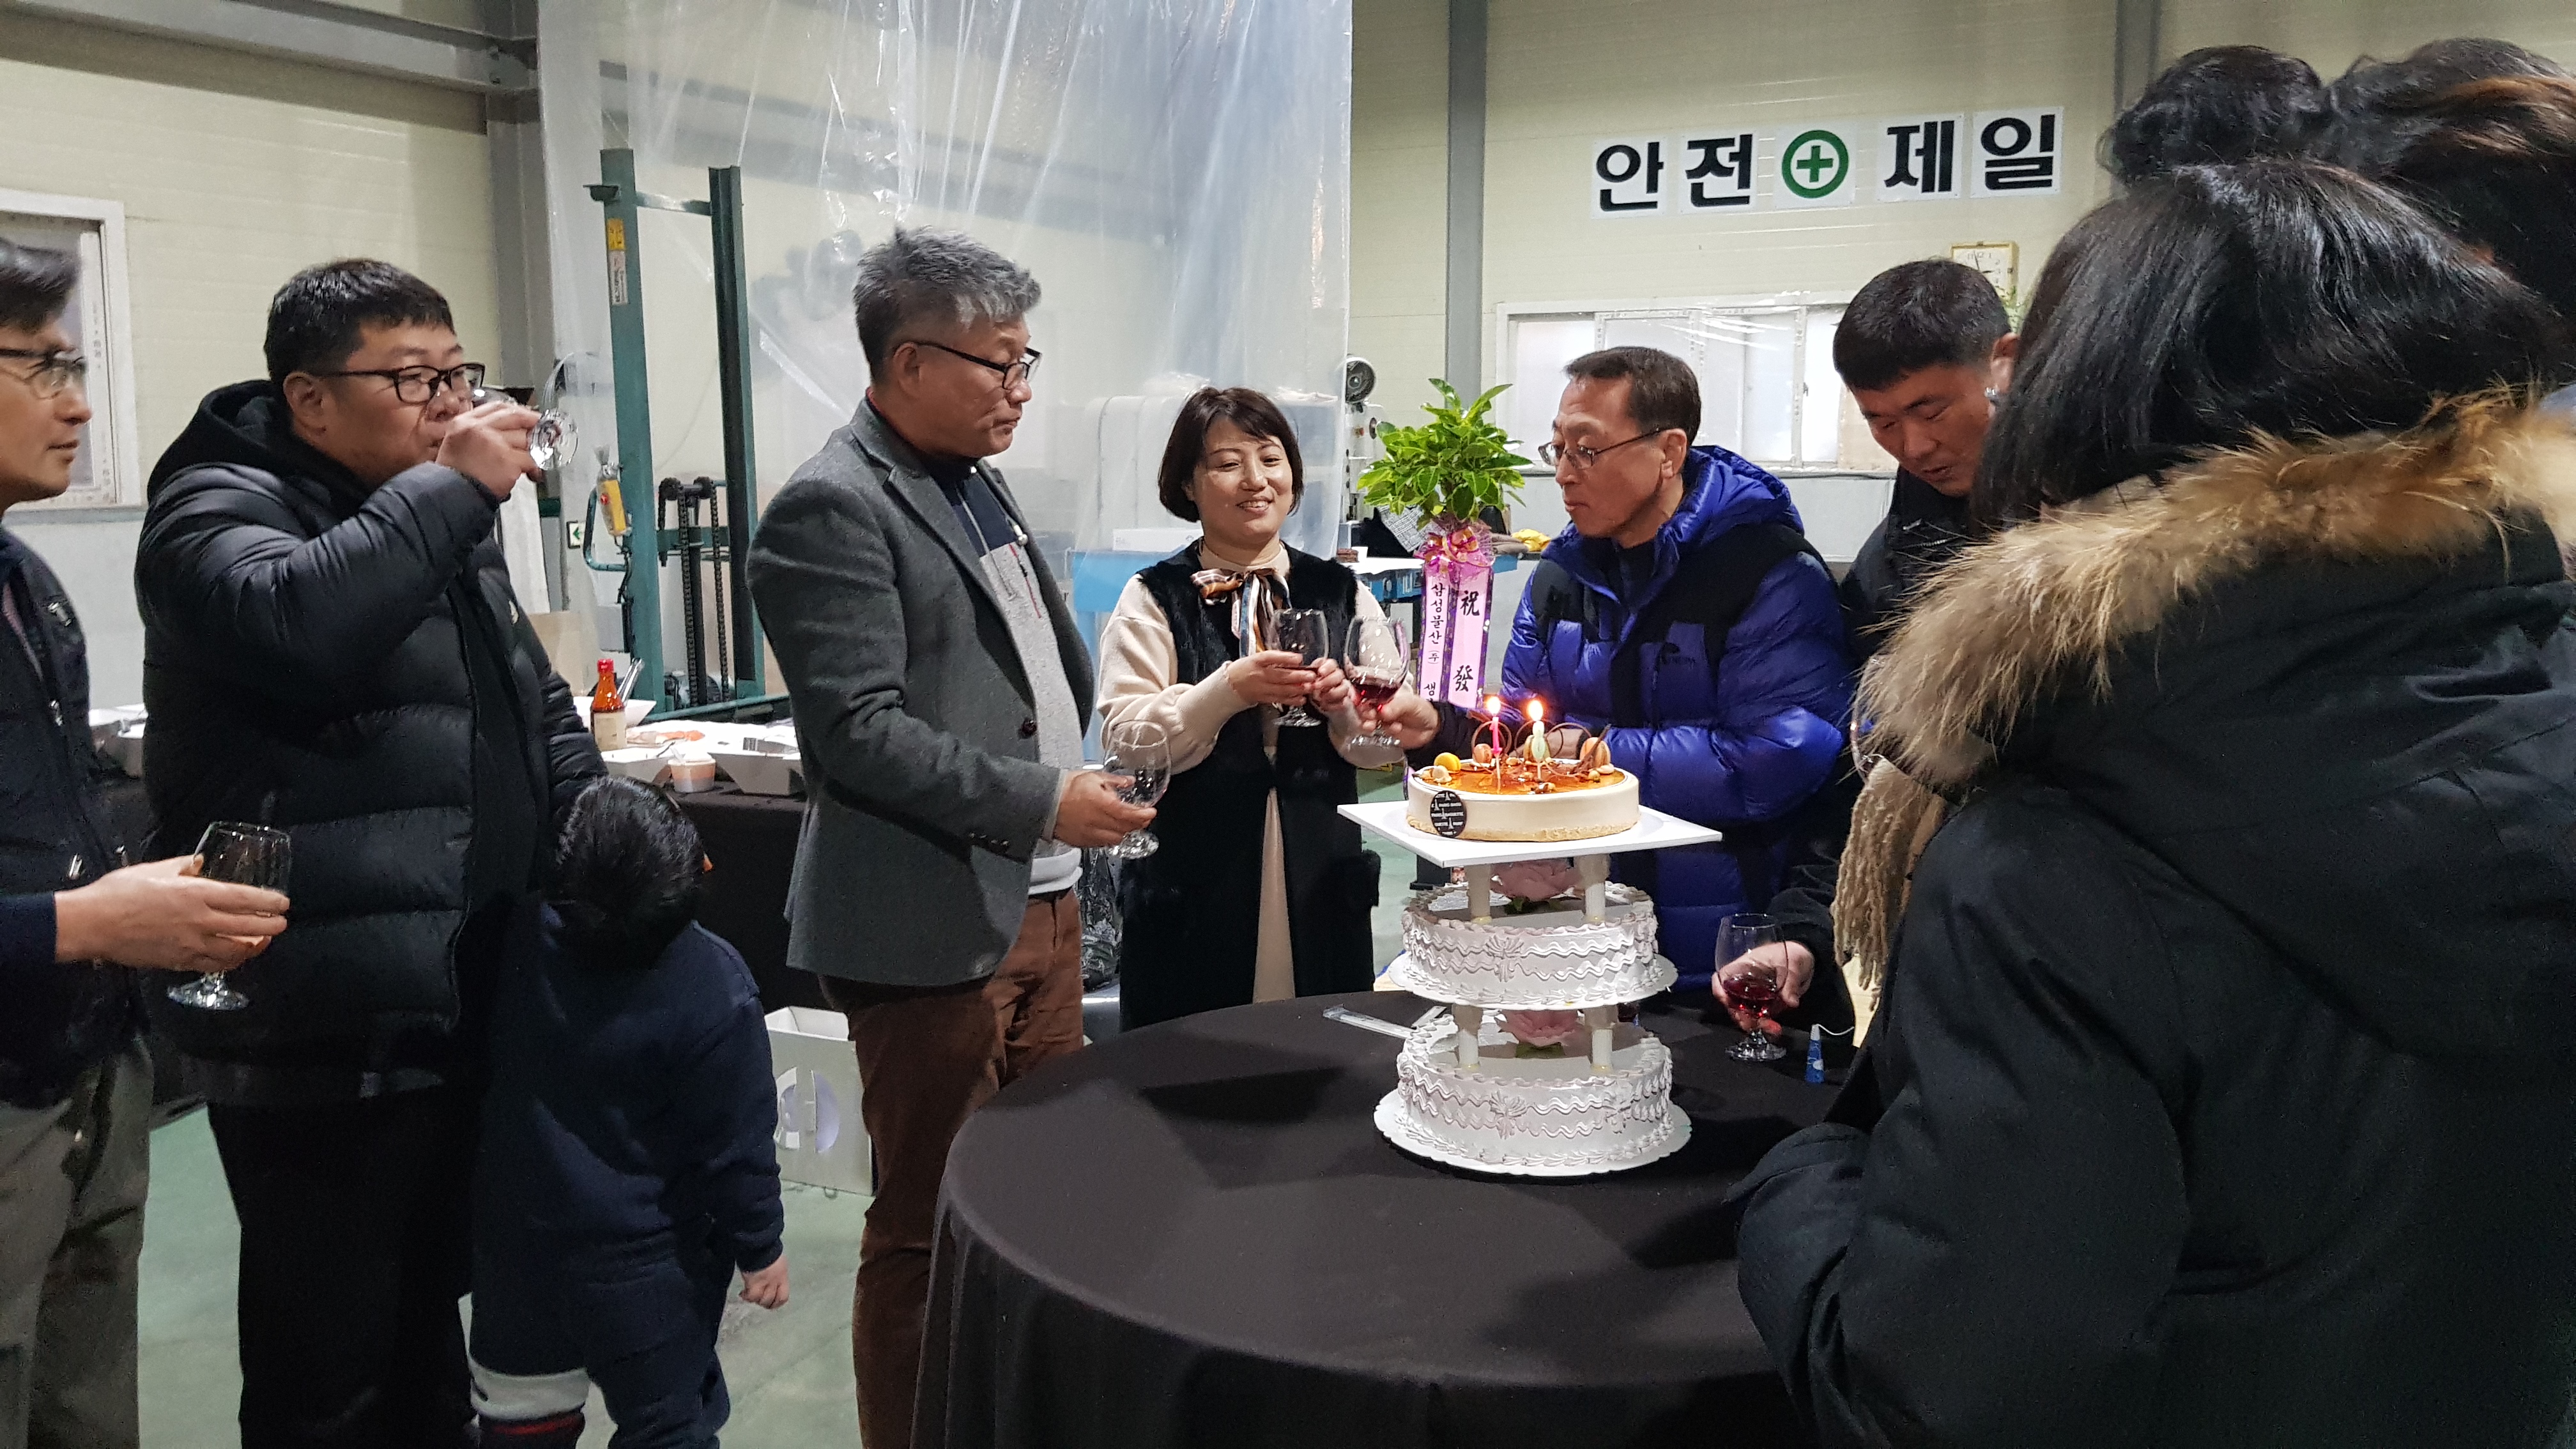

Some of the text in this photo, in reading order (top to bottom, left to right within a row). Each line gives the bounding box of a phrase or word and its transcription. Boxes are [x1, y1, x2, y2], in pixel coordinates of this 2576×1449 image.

[1596, 114, 2056, 211] 안전 제일
[1429, 582, 1446, 645] 삼성물산
[1453, 590, 1480, 693] 祝 發
